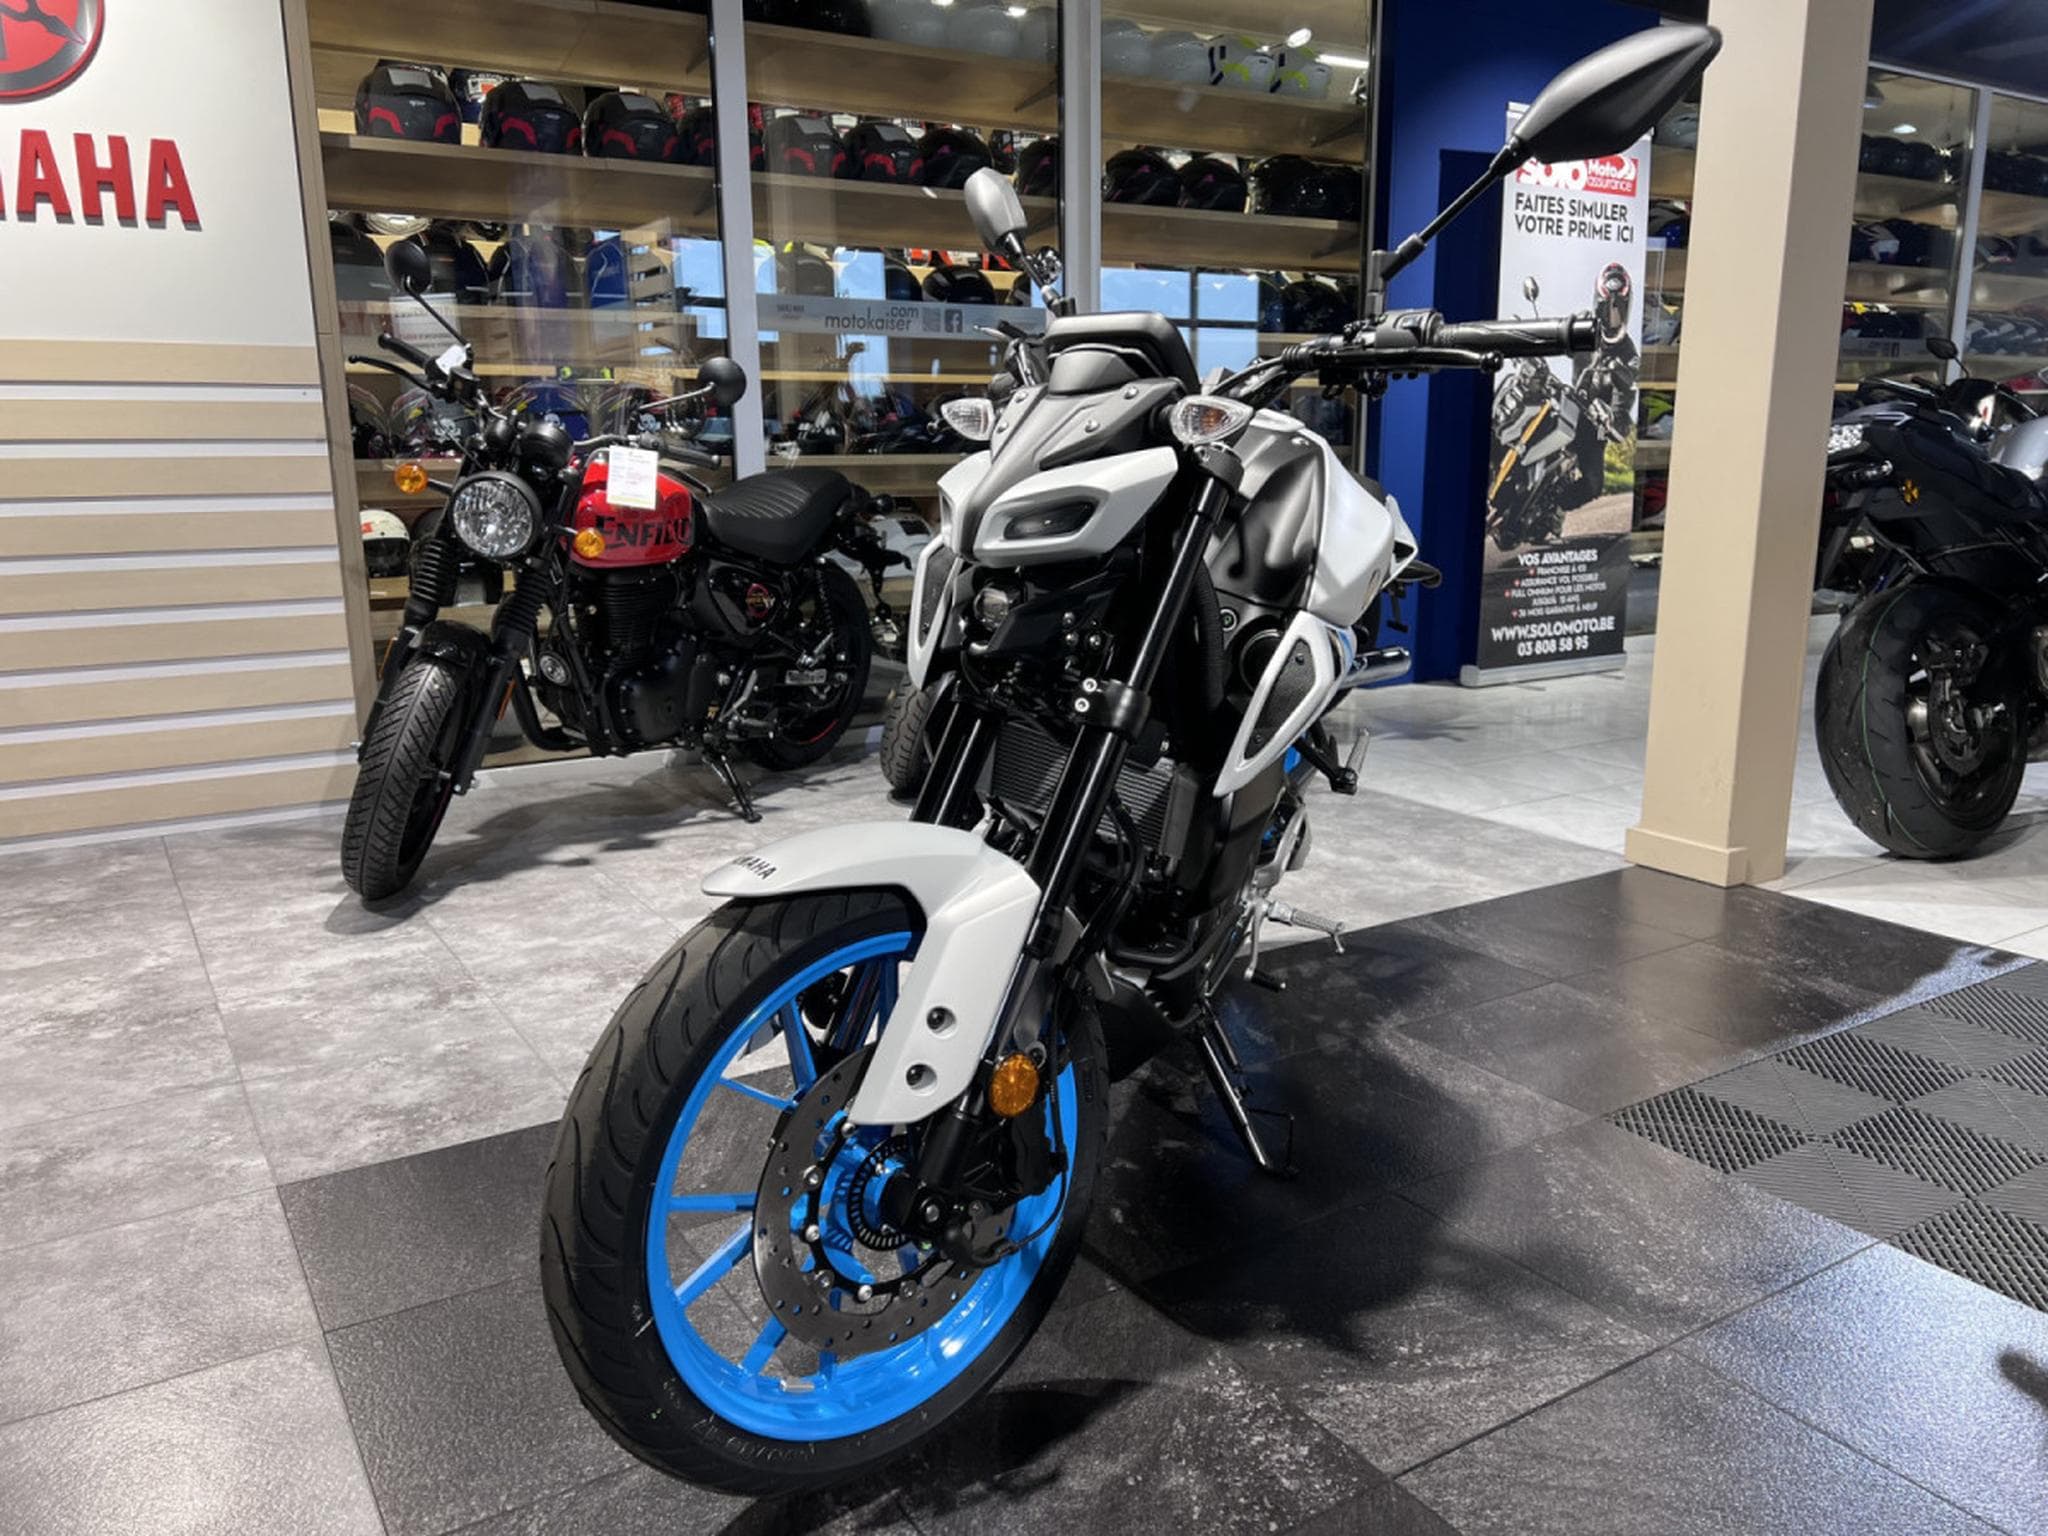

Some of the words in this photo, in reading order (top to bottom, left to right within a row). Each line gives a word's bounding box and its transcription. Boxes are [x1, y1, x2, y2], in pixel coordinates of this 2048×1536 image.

[0, 128, 201, 231] AHA
[1588, 177, 1632, 191] assurance
[1515, 192, 1564, 215] FAITES
[1568, 199, 1627, 222] SIMULER
[1514, 214, 1564, 236] VOTRE
[1568, 220, 1611, 241] PRIME
[1617, 225, 1634, 243] ICI
[825, 307, 912, 331] motokaiser
[1518, 553, 1540, 566] VOS
[1541, 549, 1598, 564] AVANTAGES
[1511, 589, 1526, 598] FULL
[1555, 585, 1572, 594] POUR
[1573, 584, 1584, 593] LES
[1585, 582, 1607, 591] MOTOS
[1521, 577, 1557, 587] ASSURANCE
[1558, 575, 1570, 584] VOL
[1528, 607, 1544, 616] MOIS
[1491, 616, 1615, 642] WWW.SOLOMOTO.BE
[1517, 641, 1533, 656] 03
[1535, 638, 1557, 655] 808
[1559, 636, 1573, 652] 58
